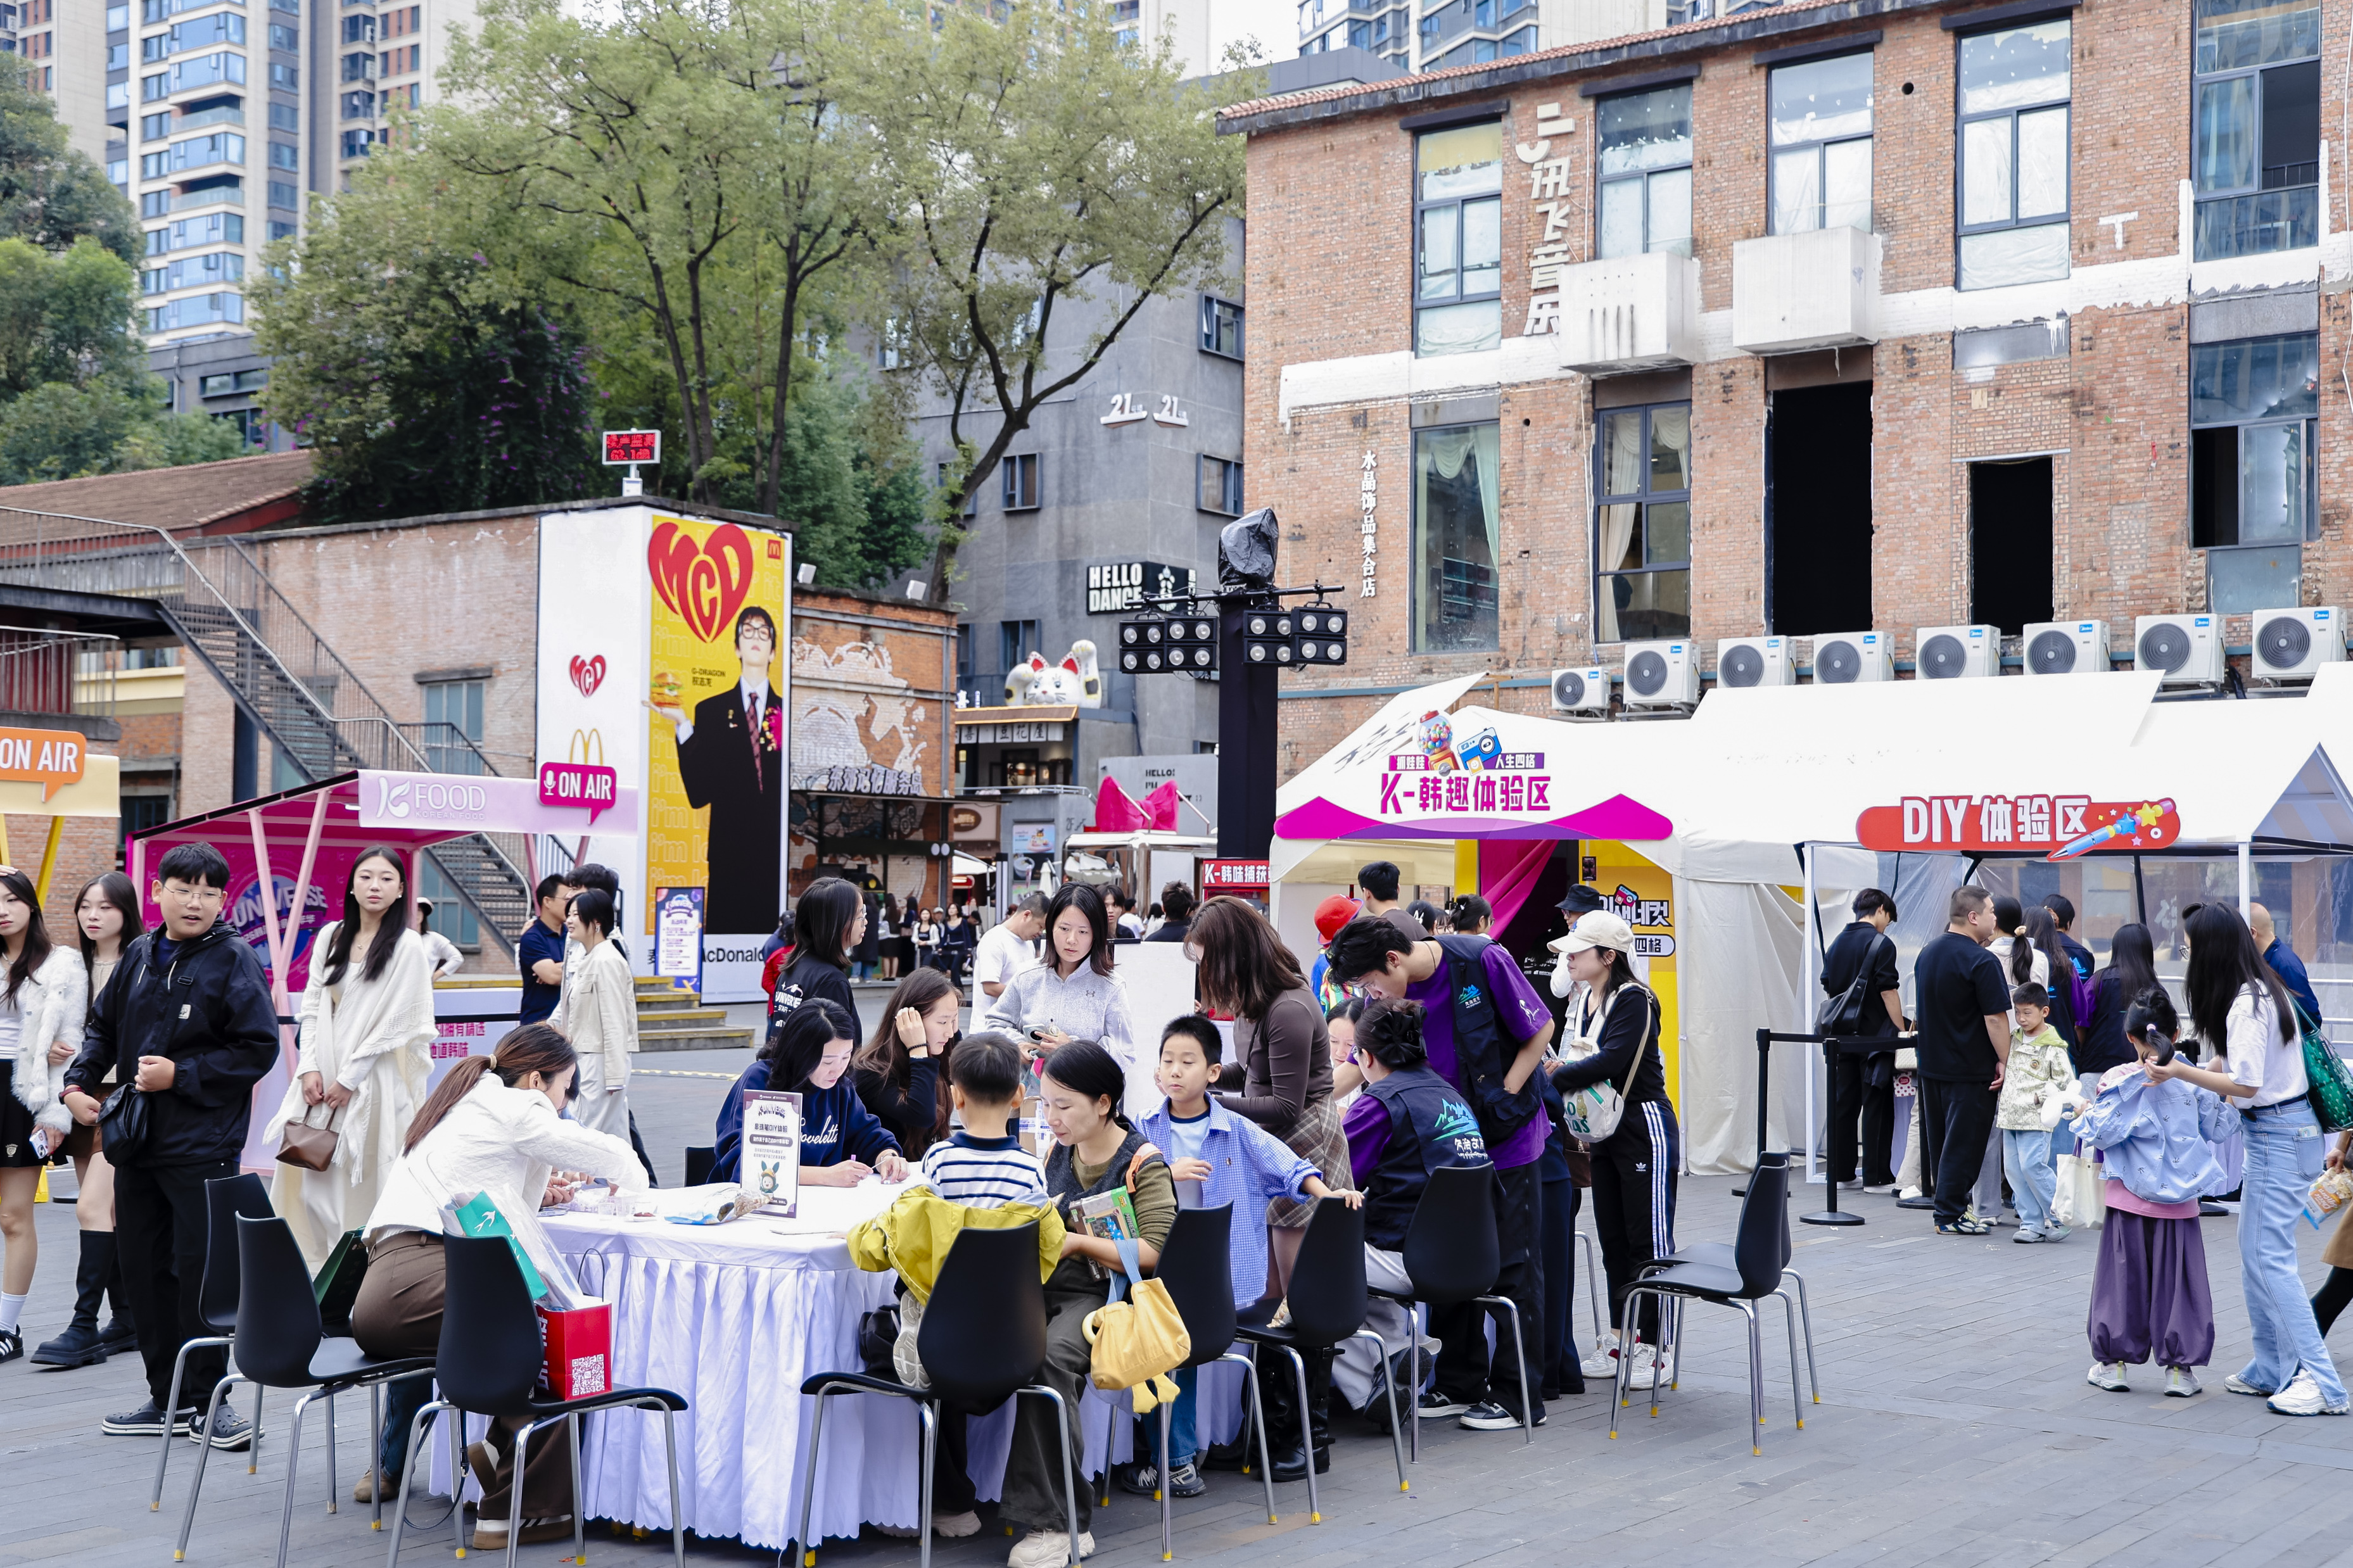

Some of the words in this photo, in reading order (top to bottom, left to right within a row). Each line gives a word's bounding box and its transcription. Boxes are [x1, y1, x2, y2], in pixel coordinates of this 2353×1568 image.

[1360, 450, 1377, 598] 水晶饰品集合店
[1089, 562, 1142, 589] HELLO
[1089, 586, 1142, 612] DANCE
[0, 738, 32, 770] ON
[37, 741, 79, 773] AIR
[1397, 756, 1425, 770] 抓娃娃
[1495, 754, 1535, 769] 人生四格
[558, 772, 581, 798] ON
[585, 774, 612, 800] AIR
[828, 766, 922, 795] 东郊记忆服务岛
[1145, 769, 1175, 777] HELLO!
[415, 783, 486, 811] FOOD
[1381, 773, 1551, 814] K-韩趣体验区
[1903, 799, 1968, 843] DIY
[1980, 797, 2088, 842] 体验区
[1205, 864, 1270, 883] K-韩味捕获
